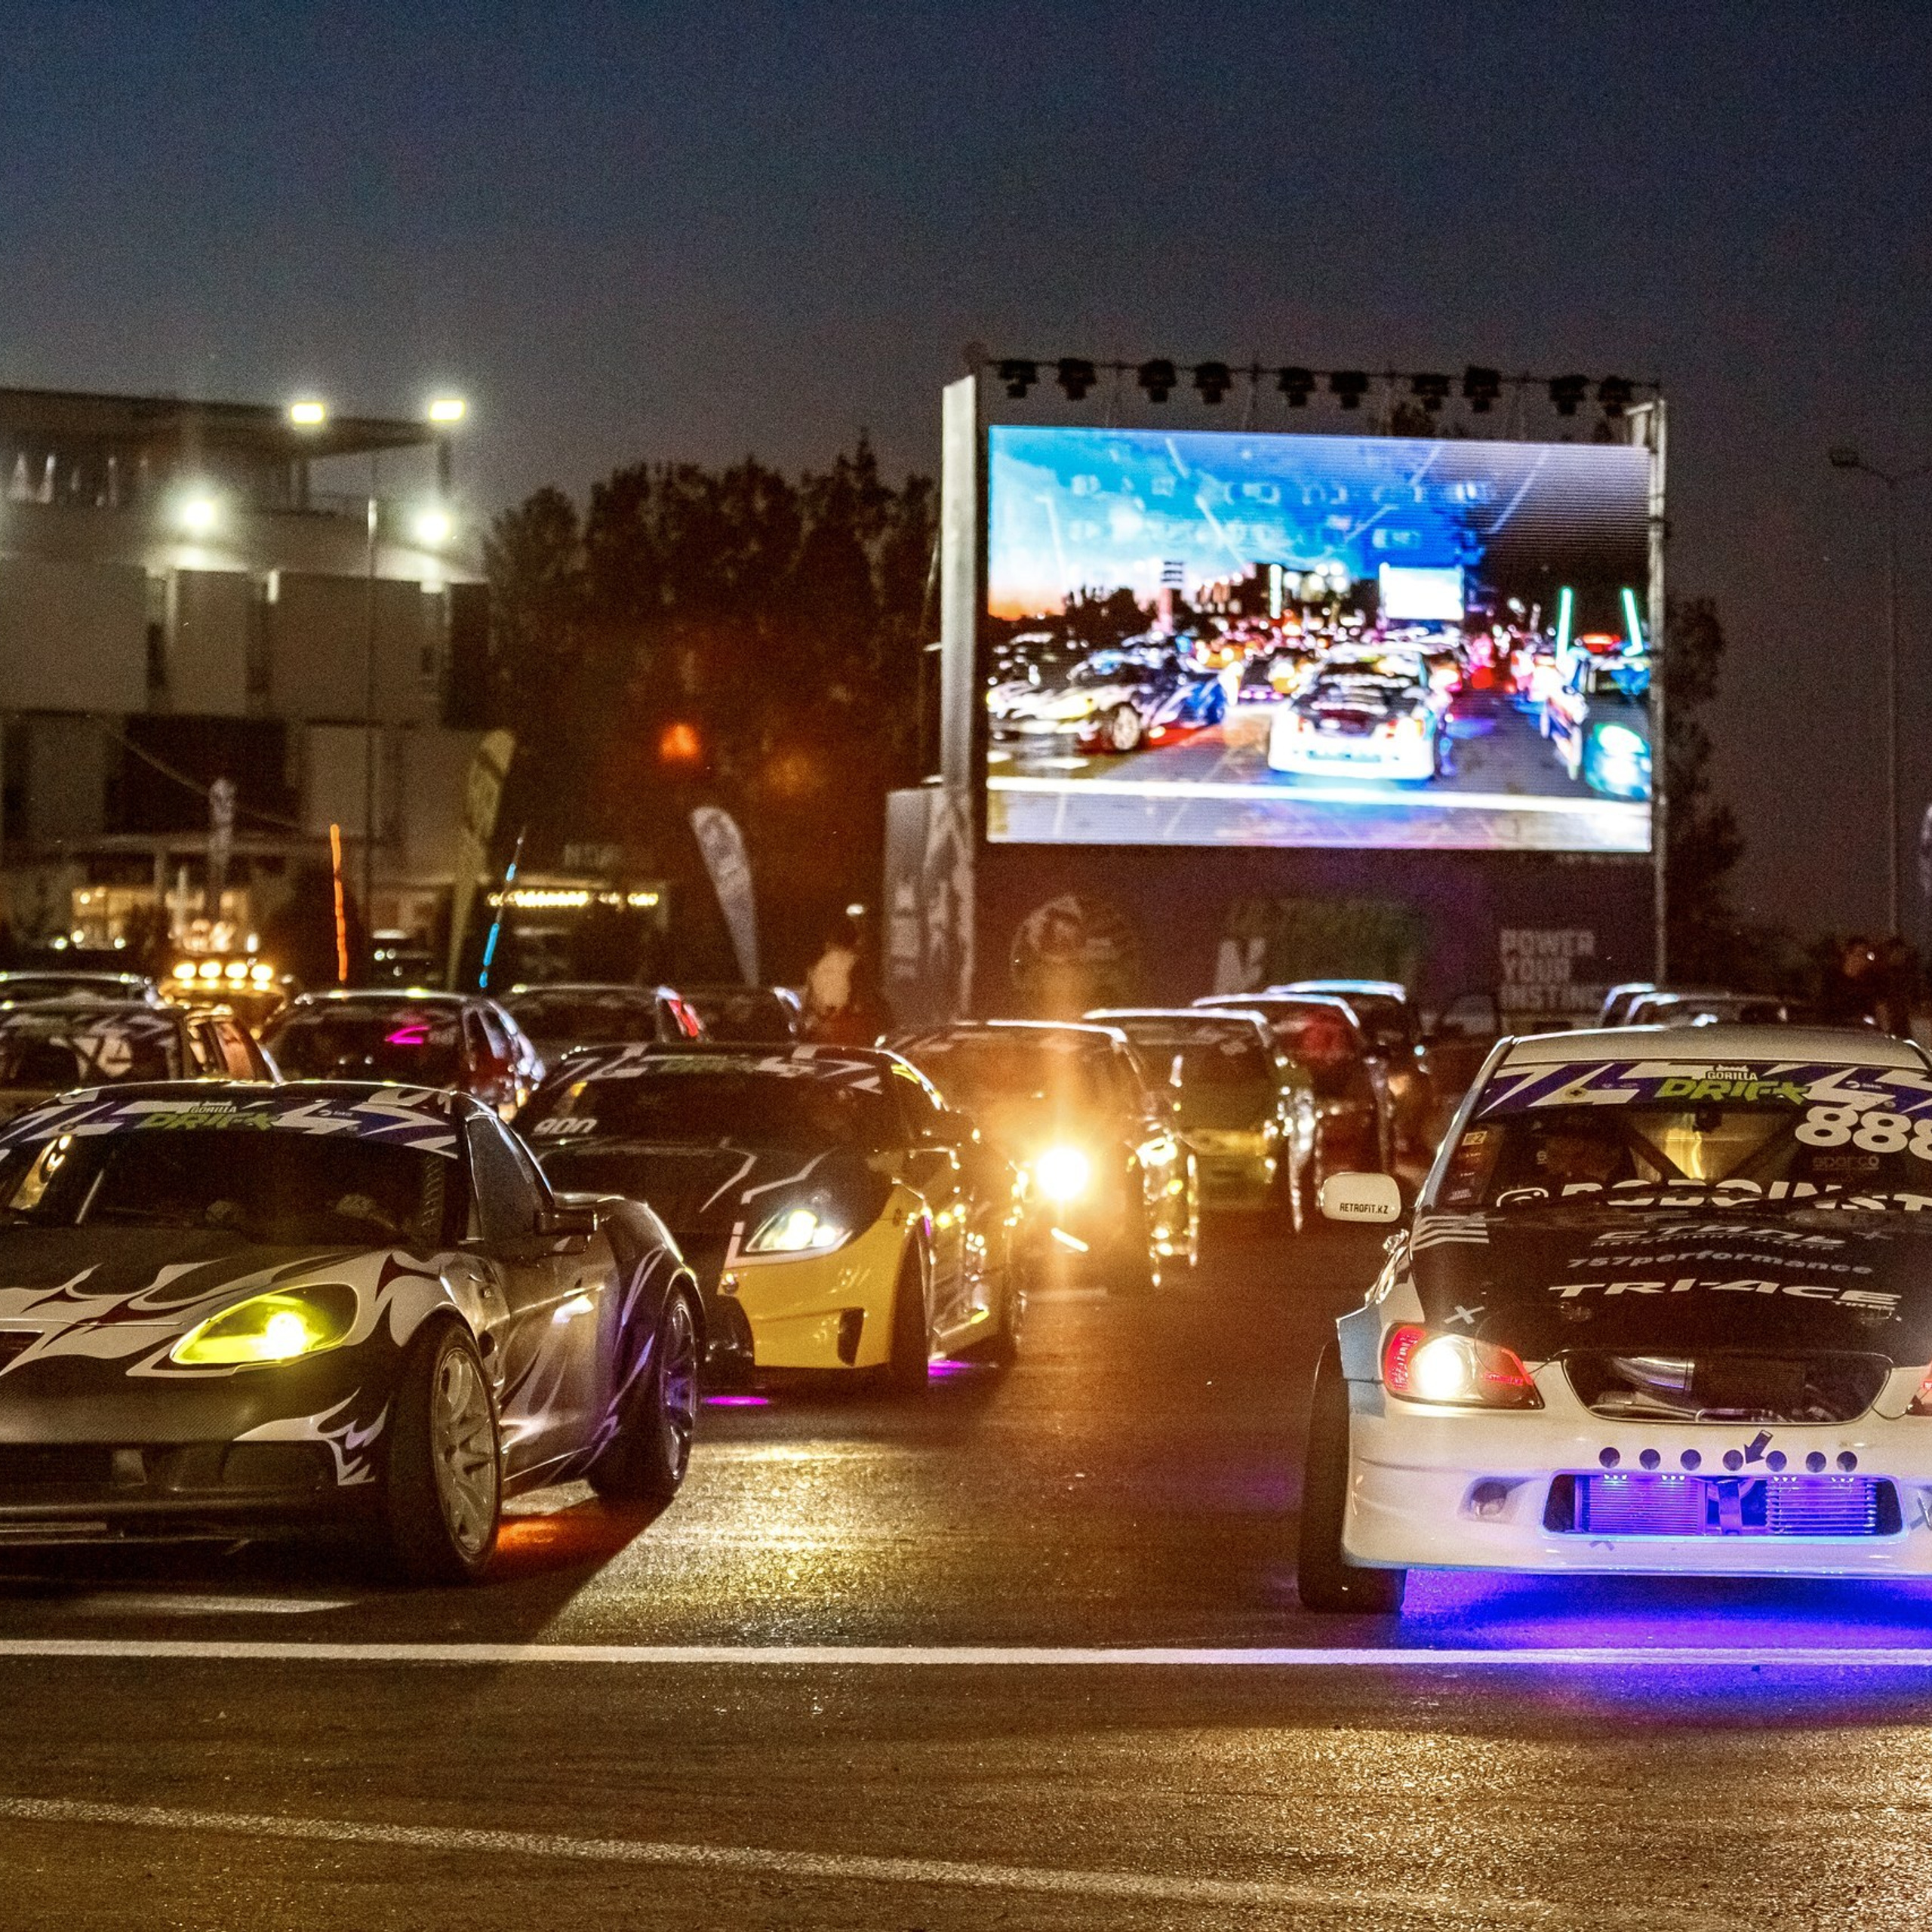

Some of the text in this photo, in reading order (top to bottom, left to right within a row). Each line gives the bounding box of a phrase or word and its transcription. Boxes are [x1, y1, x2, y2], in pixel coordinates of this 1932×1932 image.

[1500, 930, 1596, 955] POWER
[1500, 957, 1571, 982] YOUR
[1500, 984, 1605, 1010] INSTINC
[1706, 1072, 1758, 1081] GORILLA
[1654, 1078, 1811, 1105] DRIFT
[189, 1105, 238, 1114] GORILLA
[1813, 1155, 1880, 1170] sparco
[1567, 1251, 1872, 1275] 757performance
[1549, 1278, 1902, 1305] TRI-ACE
